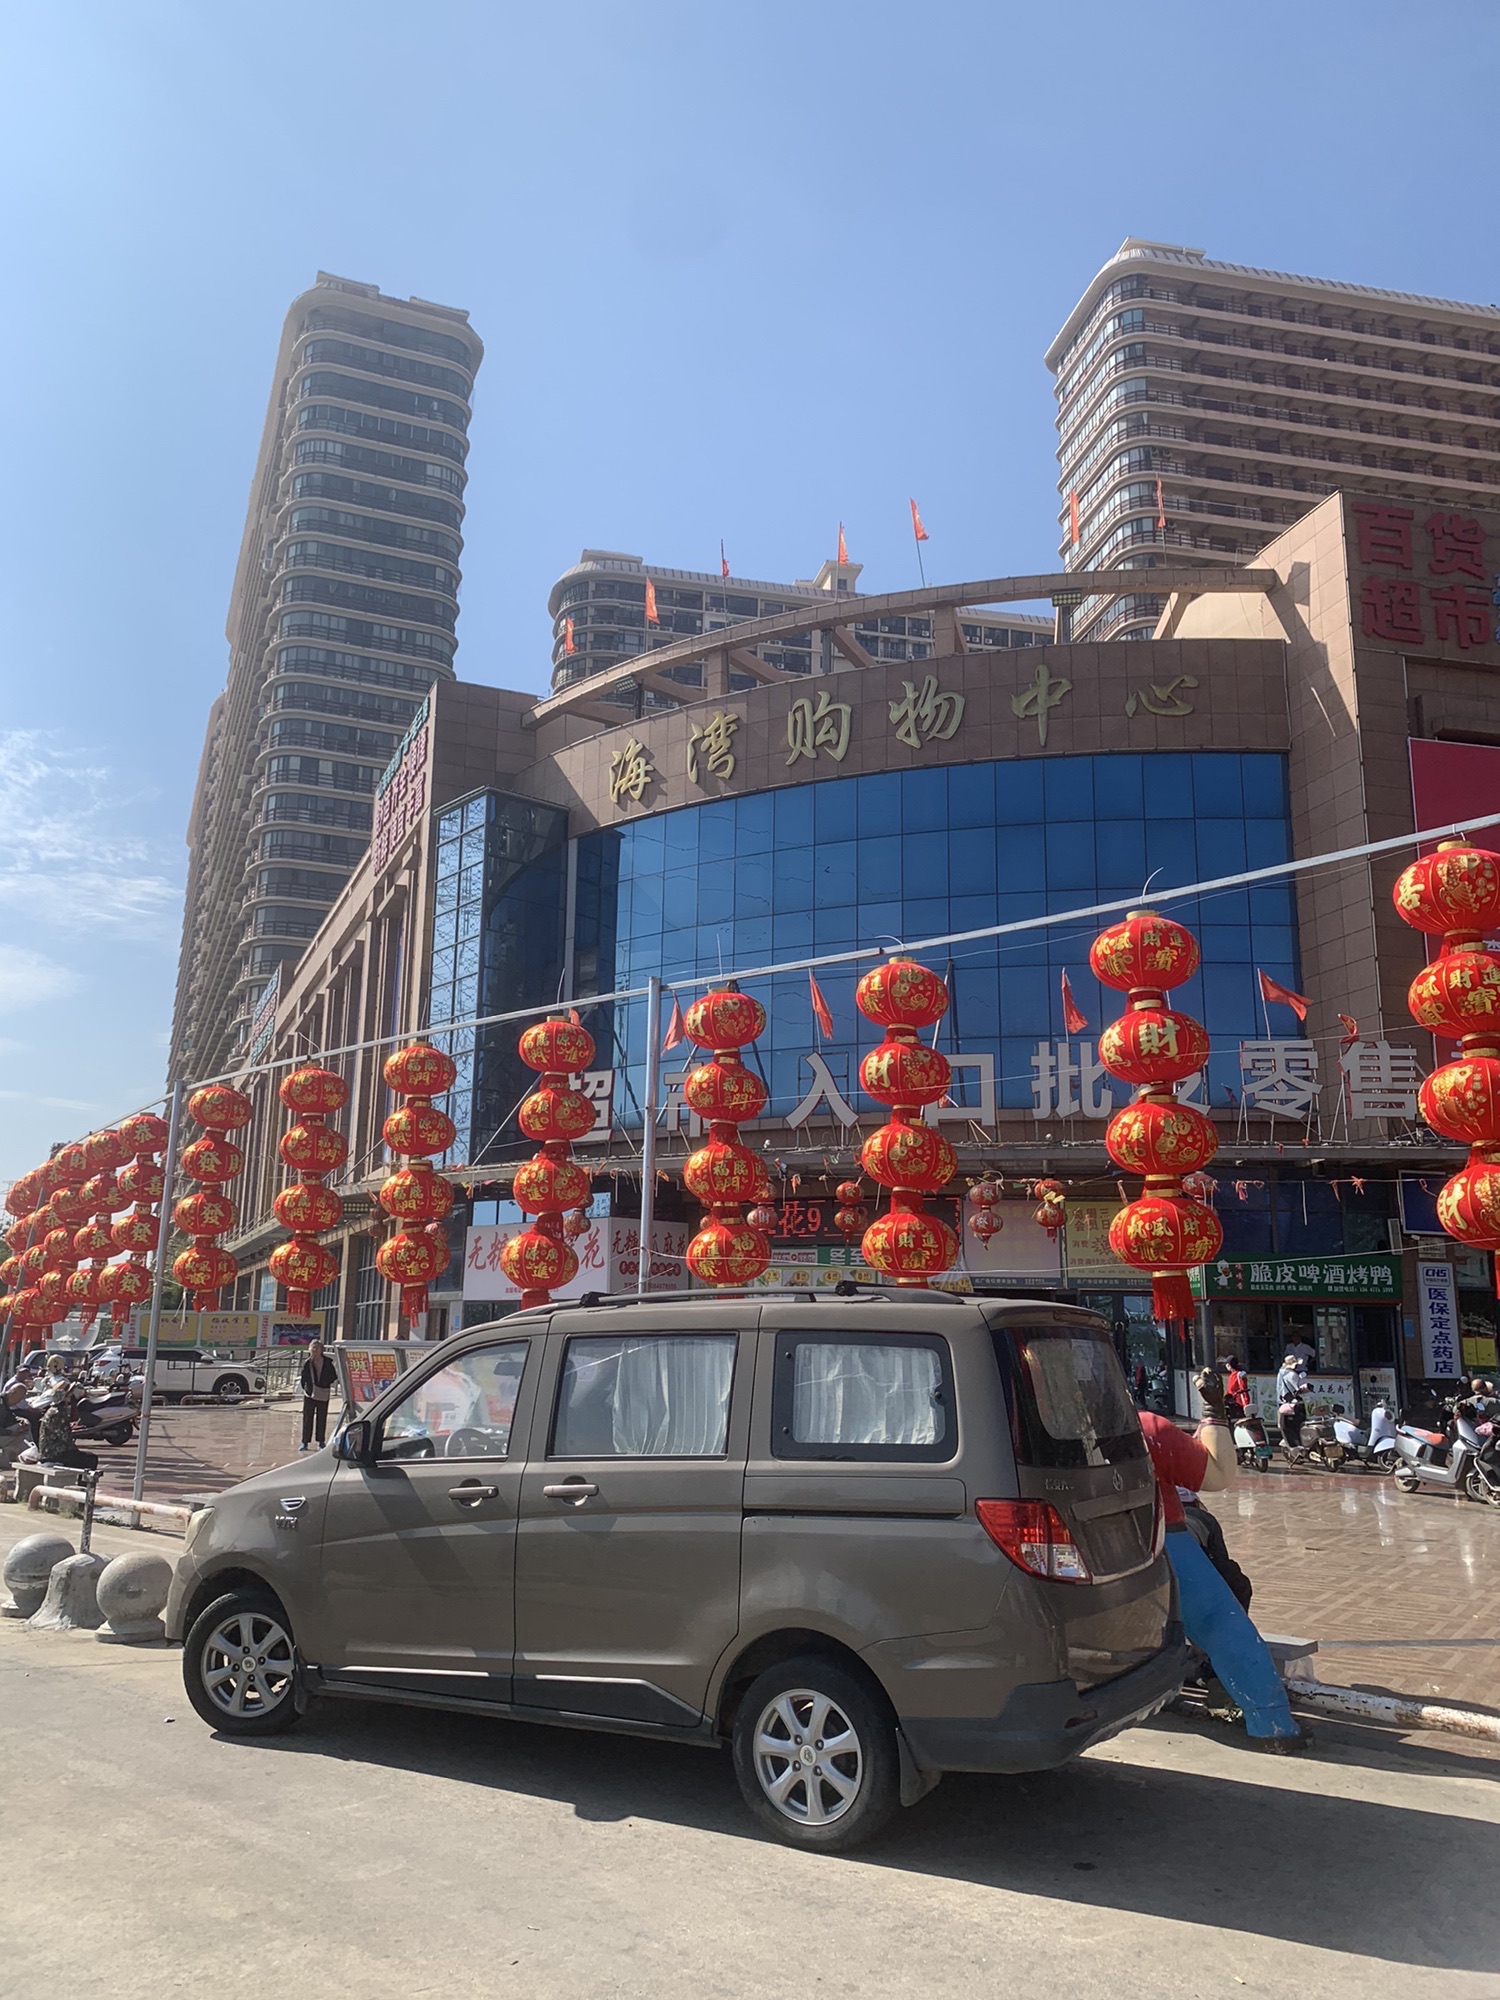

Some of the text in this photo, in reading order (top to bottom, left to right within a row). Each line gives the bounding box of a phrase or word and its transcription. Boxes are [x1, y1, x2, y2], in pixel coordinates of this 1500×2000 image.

[1351, 501, 1488, 579] 百货
[1360, 575, 1491, 650] 超市
[609, 664, 1199, 805] 海湾购物中心
[1250, 1263, 1393, 1286] 脆皮啤酒烤鸭
[1425, 1268, 1447, 1278] CHS
[1427, 1287, 1453, 1374] 医保定点药店
